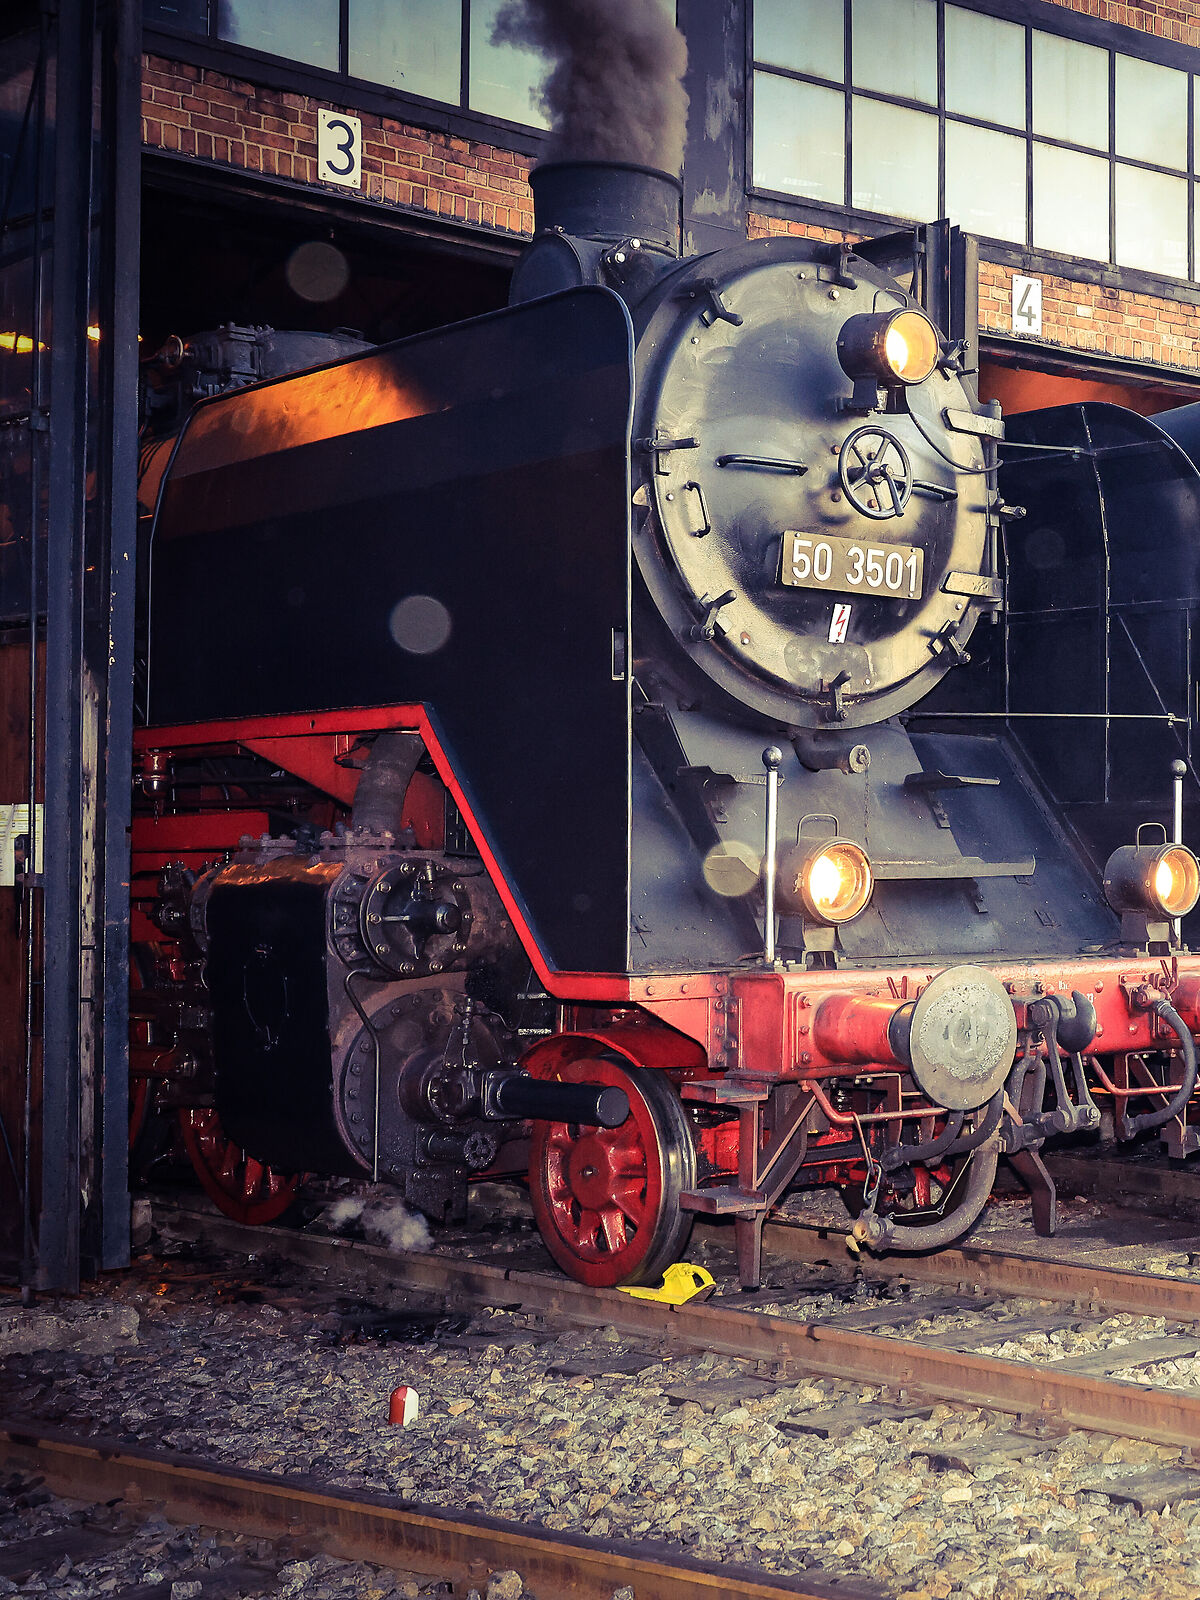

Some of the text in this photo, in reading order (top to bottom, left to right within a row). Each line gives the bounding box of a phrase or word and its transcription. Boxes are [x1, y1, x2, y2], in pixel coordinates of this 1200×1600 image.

[326, 119, 355, 176] 3
[1017, 283, 1037, 327] 4
[792, 539, 918, 593] 50 3501
